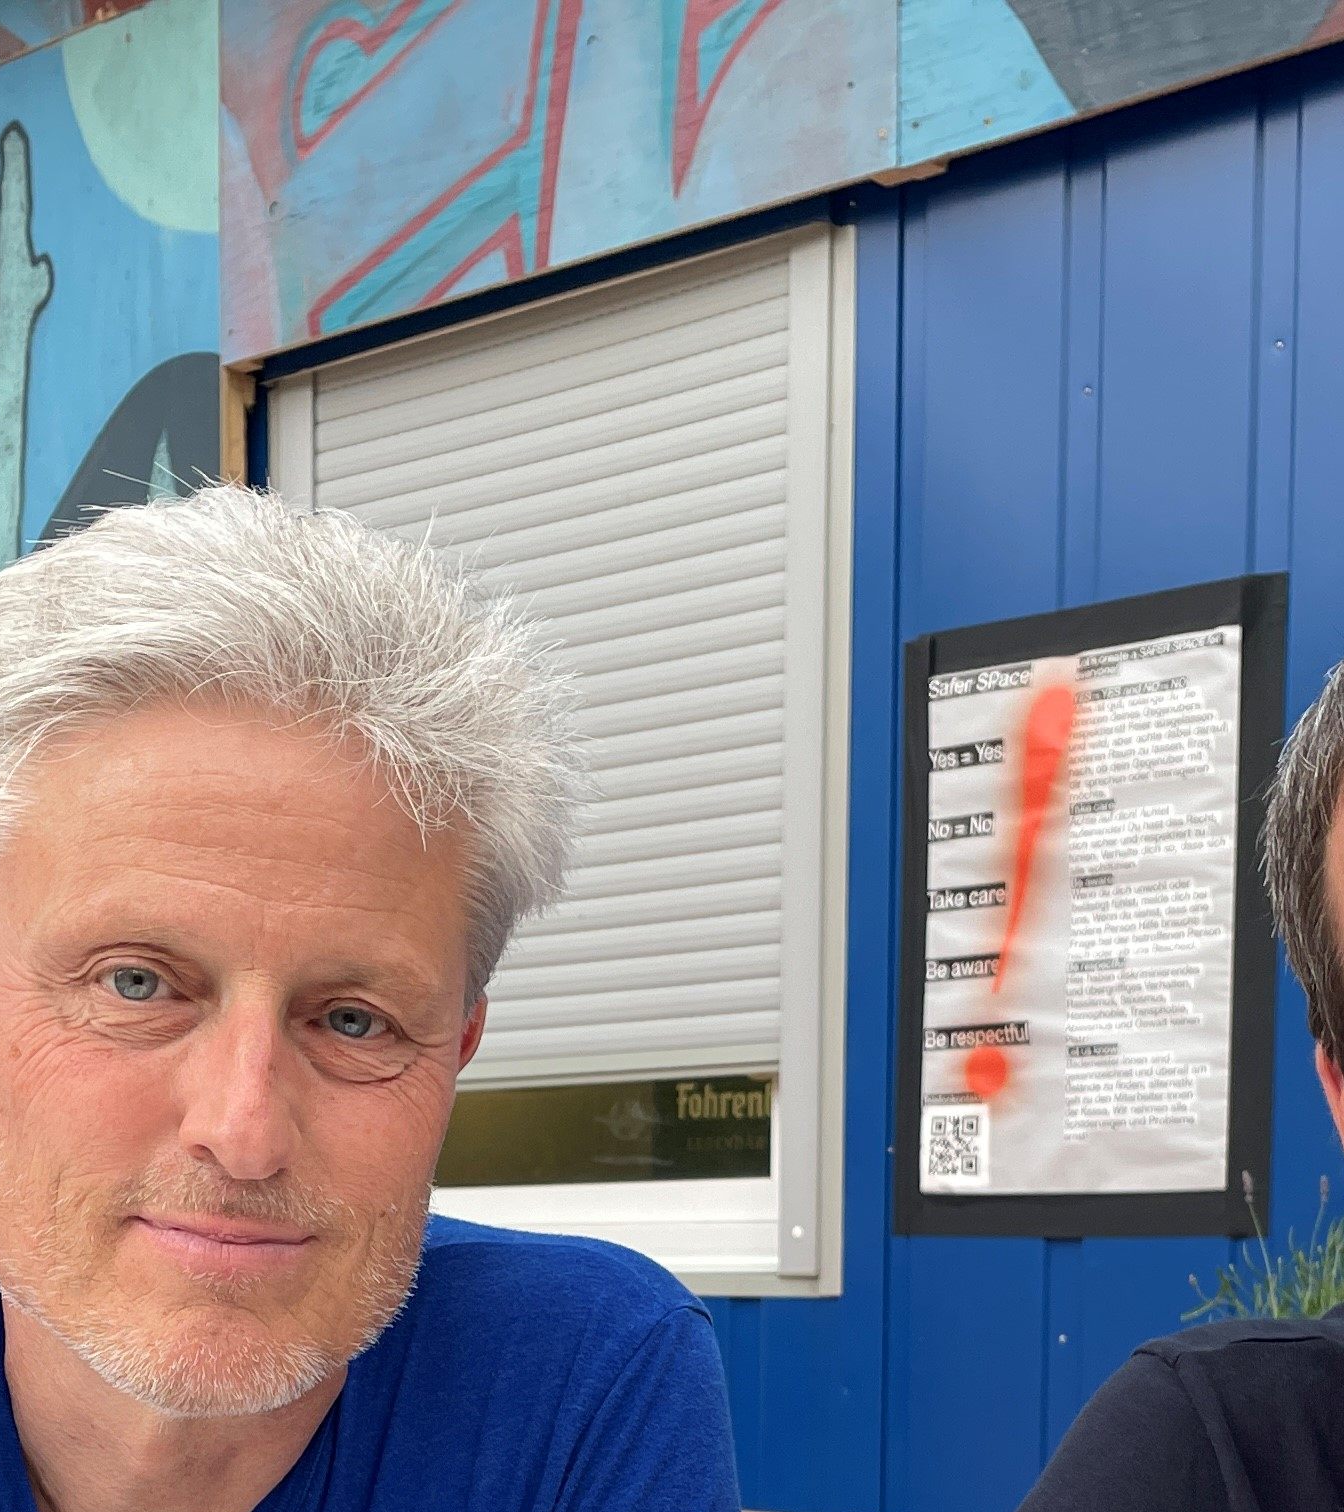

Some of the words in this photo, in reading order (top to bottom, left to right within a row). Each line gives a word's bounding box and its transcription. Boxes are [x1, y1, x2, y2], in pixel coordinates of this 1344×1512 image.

[929, 678, 973, 699] Safer
[929, 751, 959, 770] Yes
[975, 743, 1003, 762] Yes
[928, 821, 949, 840] No
[970, 815, 993, 835] No
[927, 891, 965, 910] Take
[968, 886, 1006, 906] care
[926, 961, 946, 980] Be
[950, 957, 1000, 977] aware
[924, 1030, 947, 1049] Be
[950, 1021, 1030, 1047] respectful
